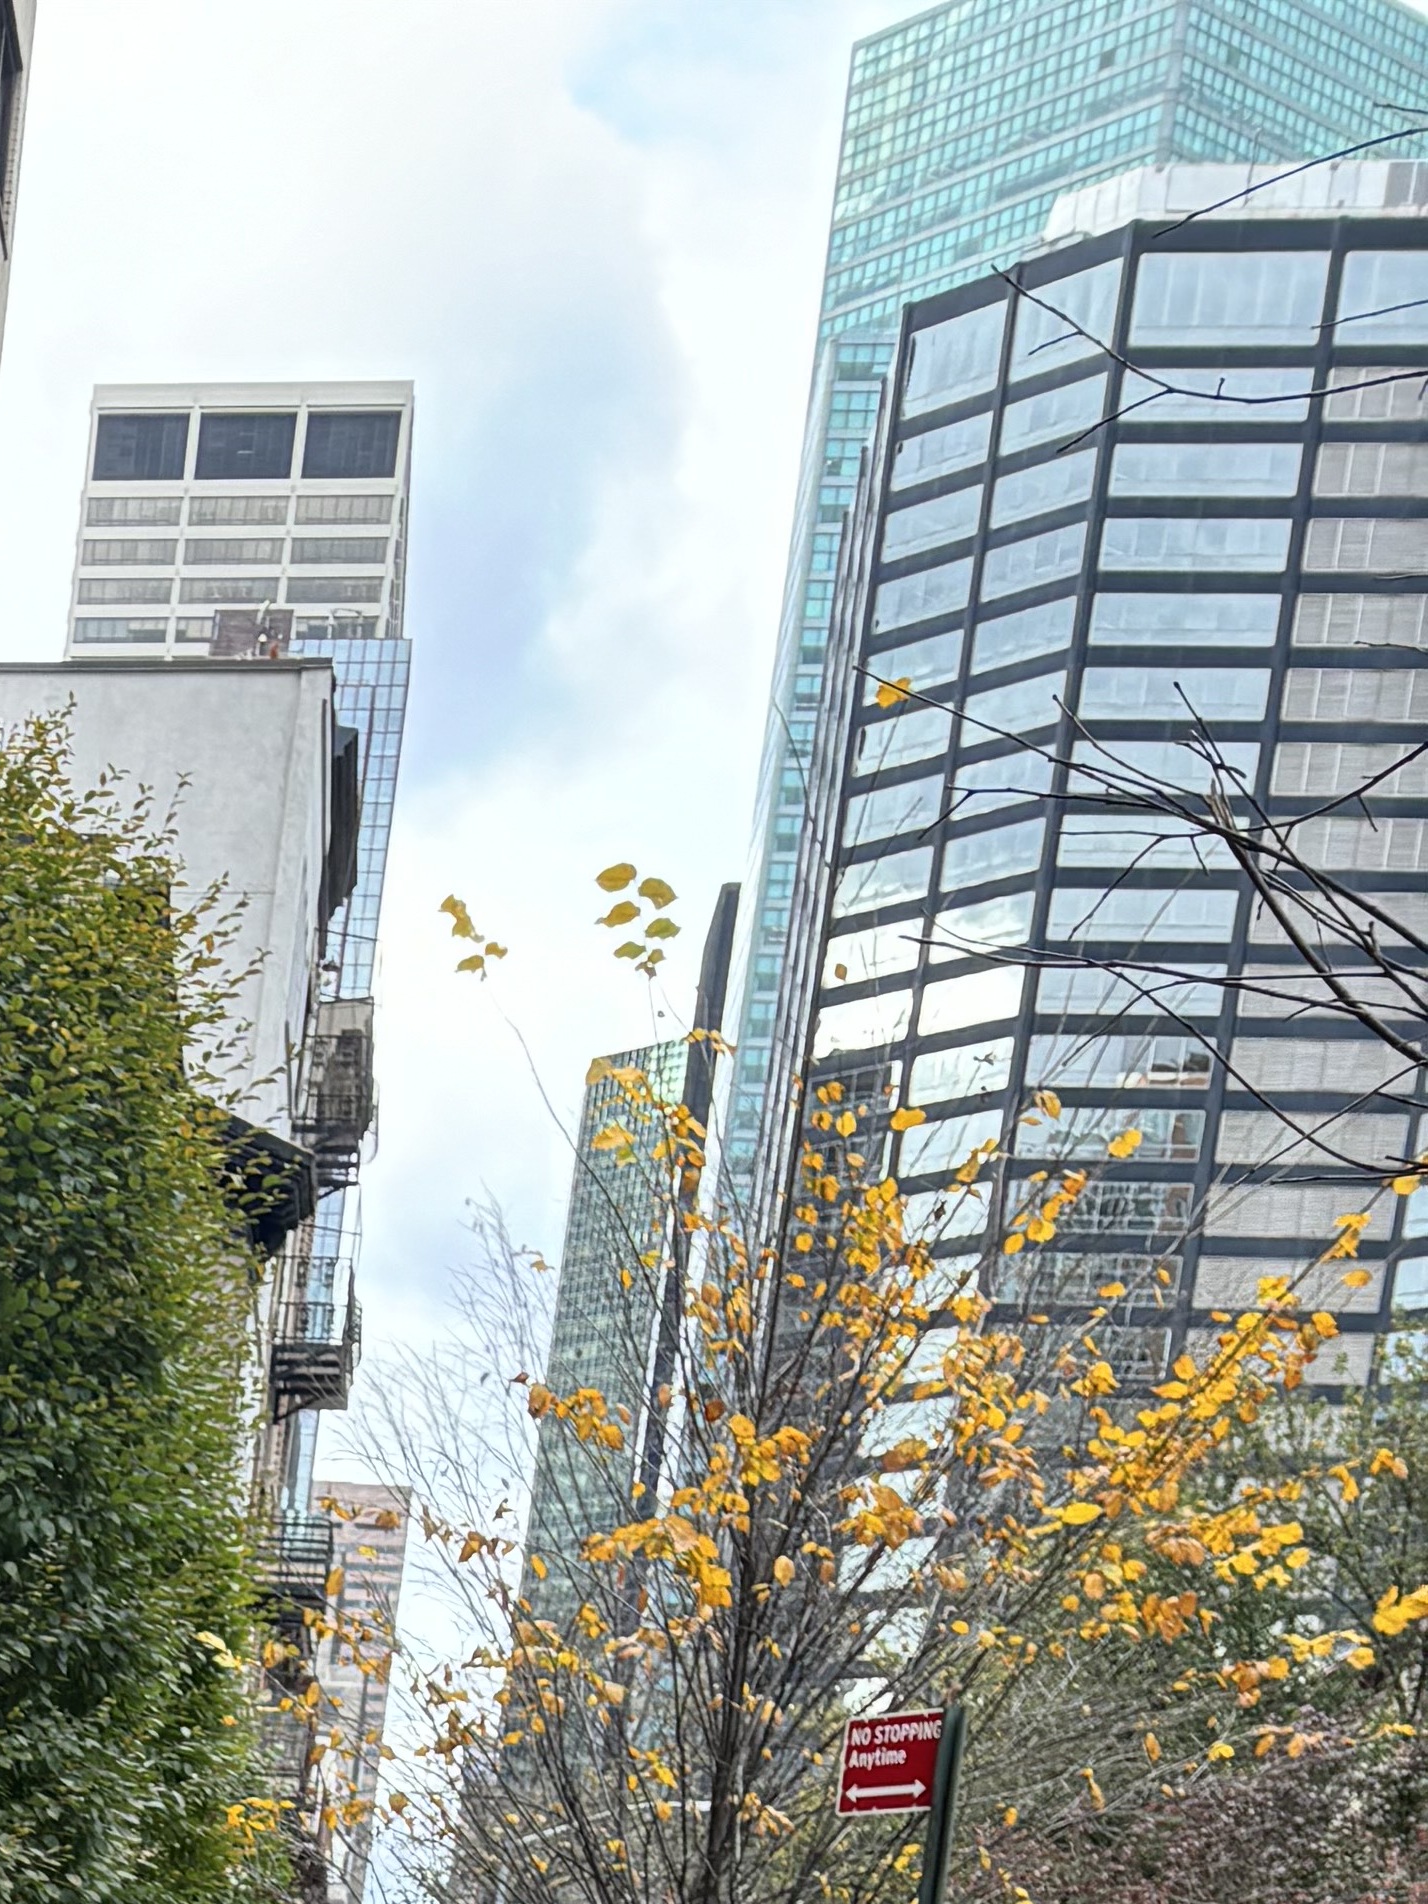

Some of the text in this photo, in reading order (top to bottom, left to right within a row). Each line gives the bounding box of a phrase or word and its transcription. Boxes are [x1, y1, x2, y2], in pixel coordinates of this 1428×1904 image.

[851, 1720, 942, 1746] NO STOPPING
[848, 1747, 907, 1771] Anytime
